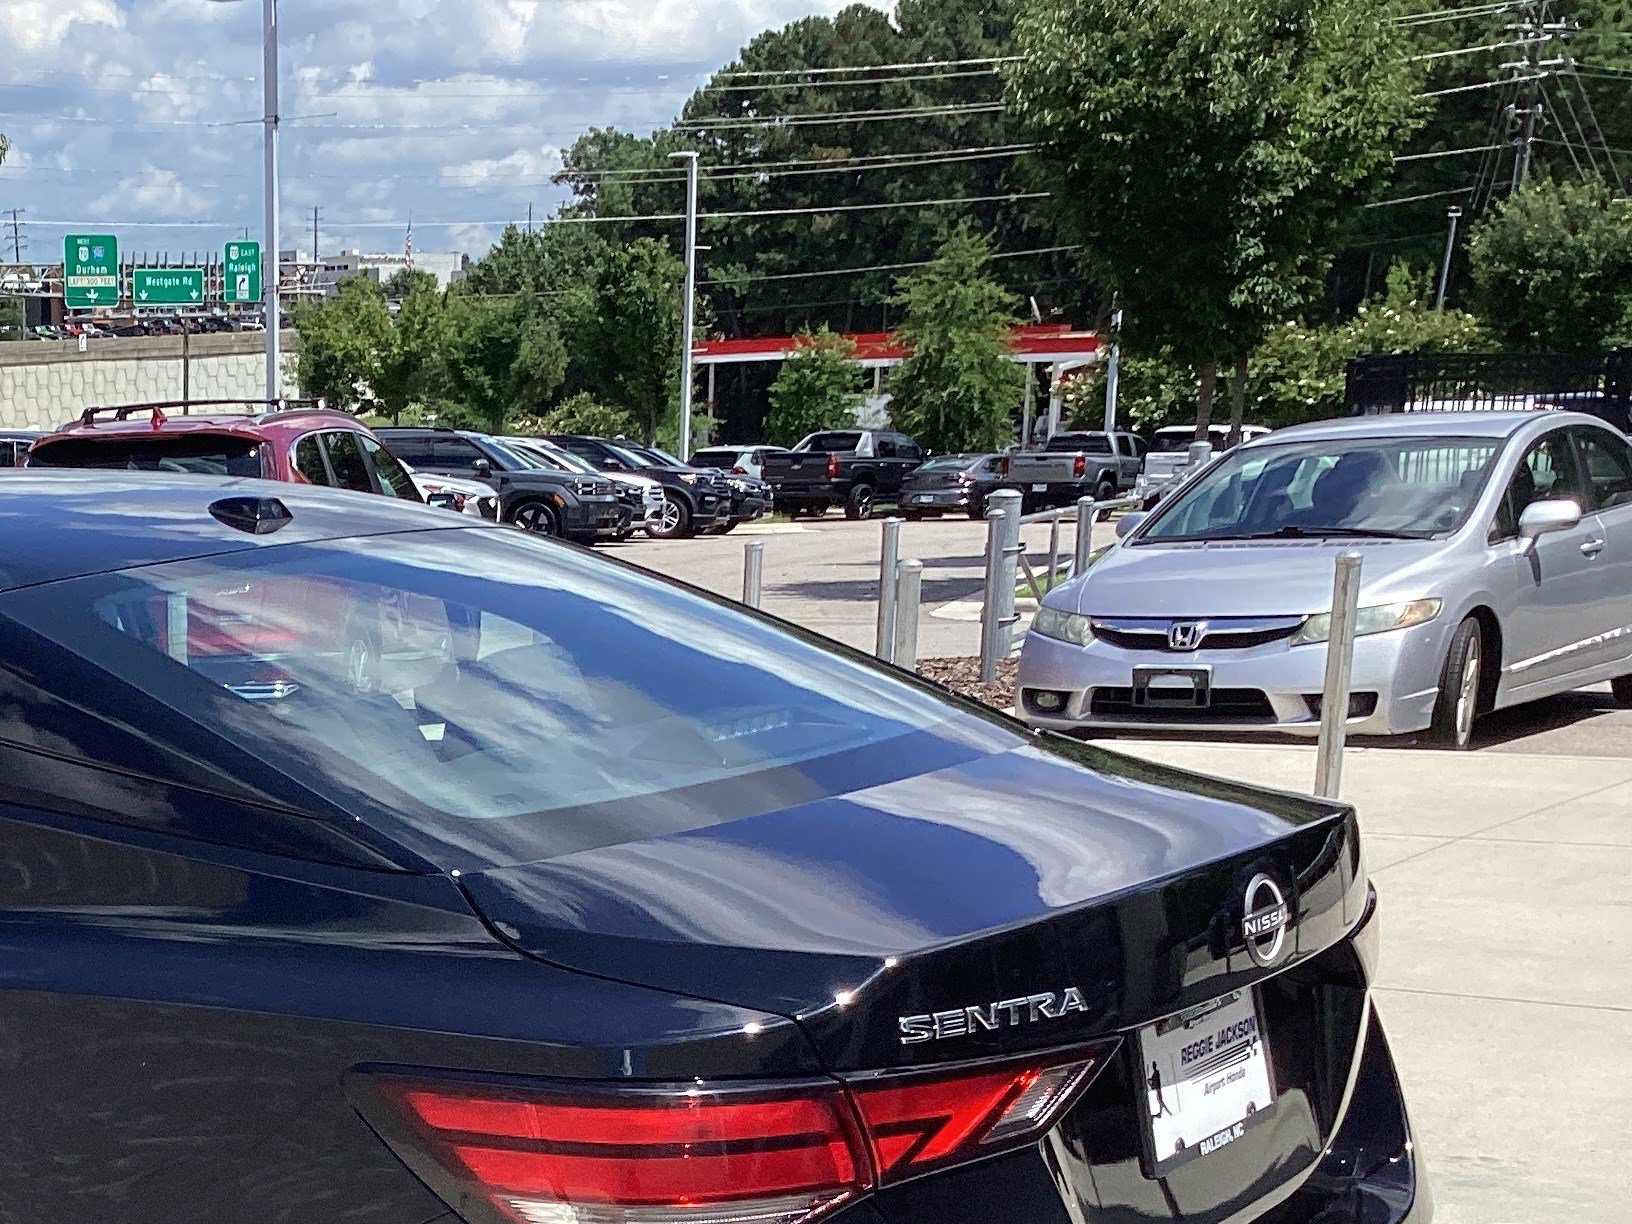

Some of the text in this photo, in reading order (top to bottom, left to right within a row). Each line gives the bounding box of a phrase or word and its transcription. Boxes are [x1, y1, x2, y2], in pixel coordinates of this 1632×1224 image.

[76, 265, 108, 275] Durham
[229, 262, 256, 274] Raleigh
[145, 276, 193, 288] Westgate Rd
[899, 986, 1089, 1045] SENTRA
[1181, 1015, 1256, 1066] REGGIE JACKSON
[1203, 1066, 1246, 1096] Airport Honda
[1232, 1122, 1245, 1139] NC
